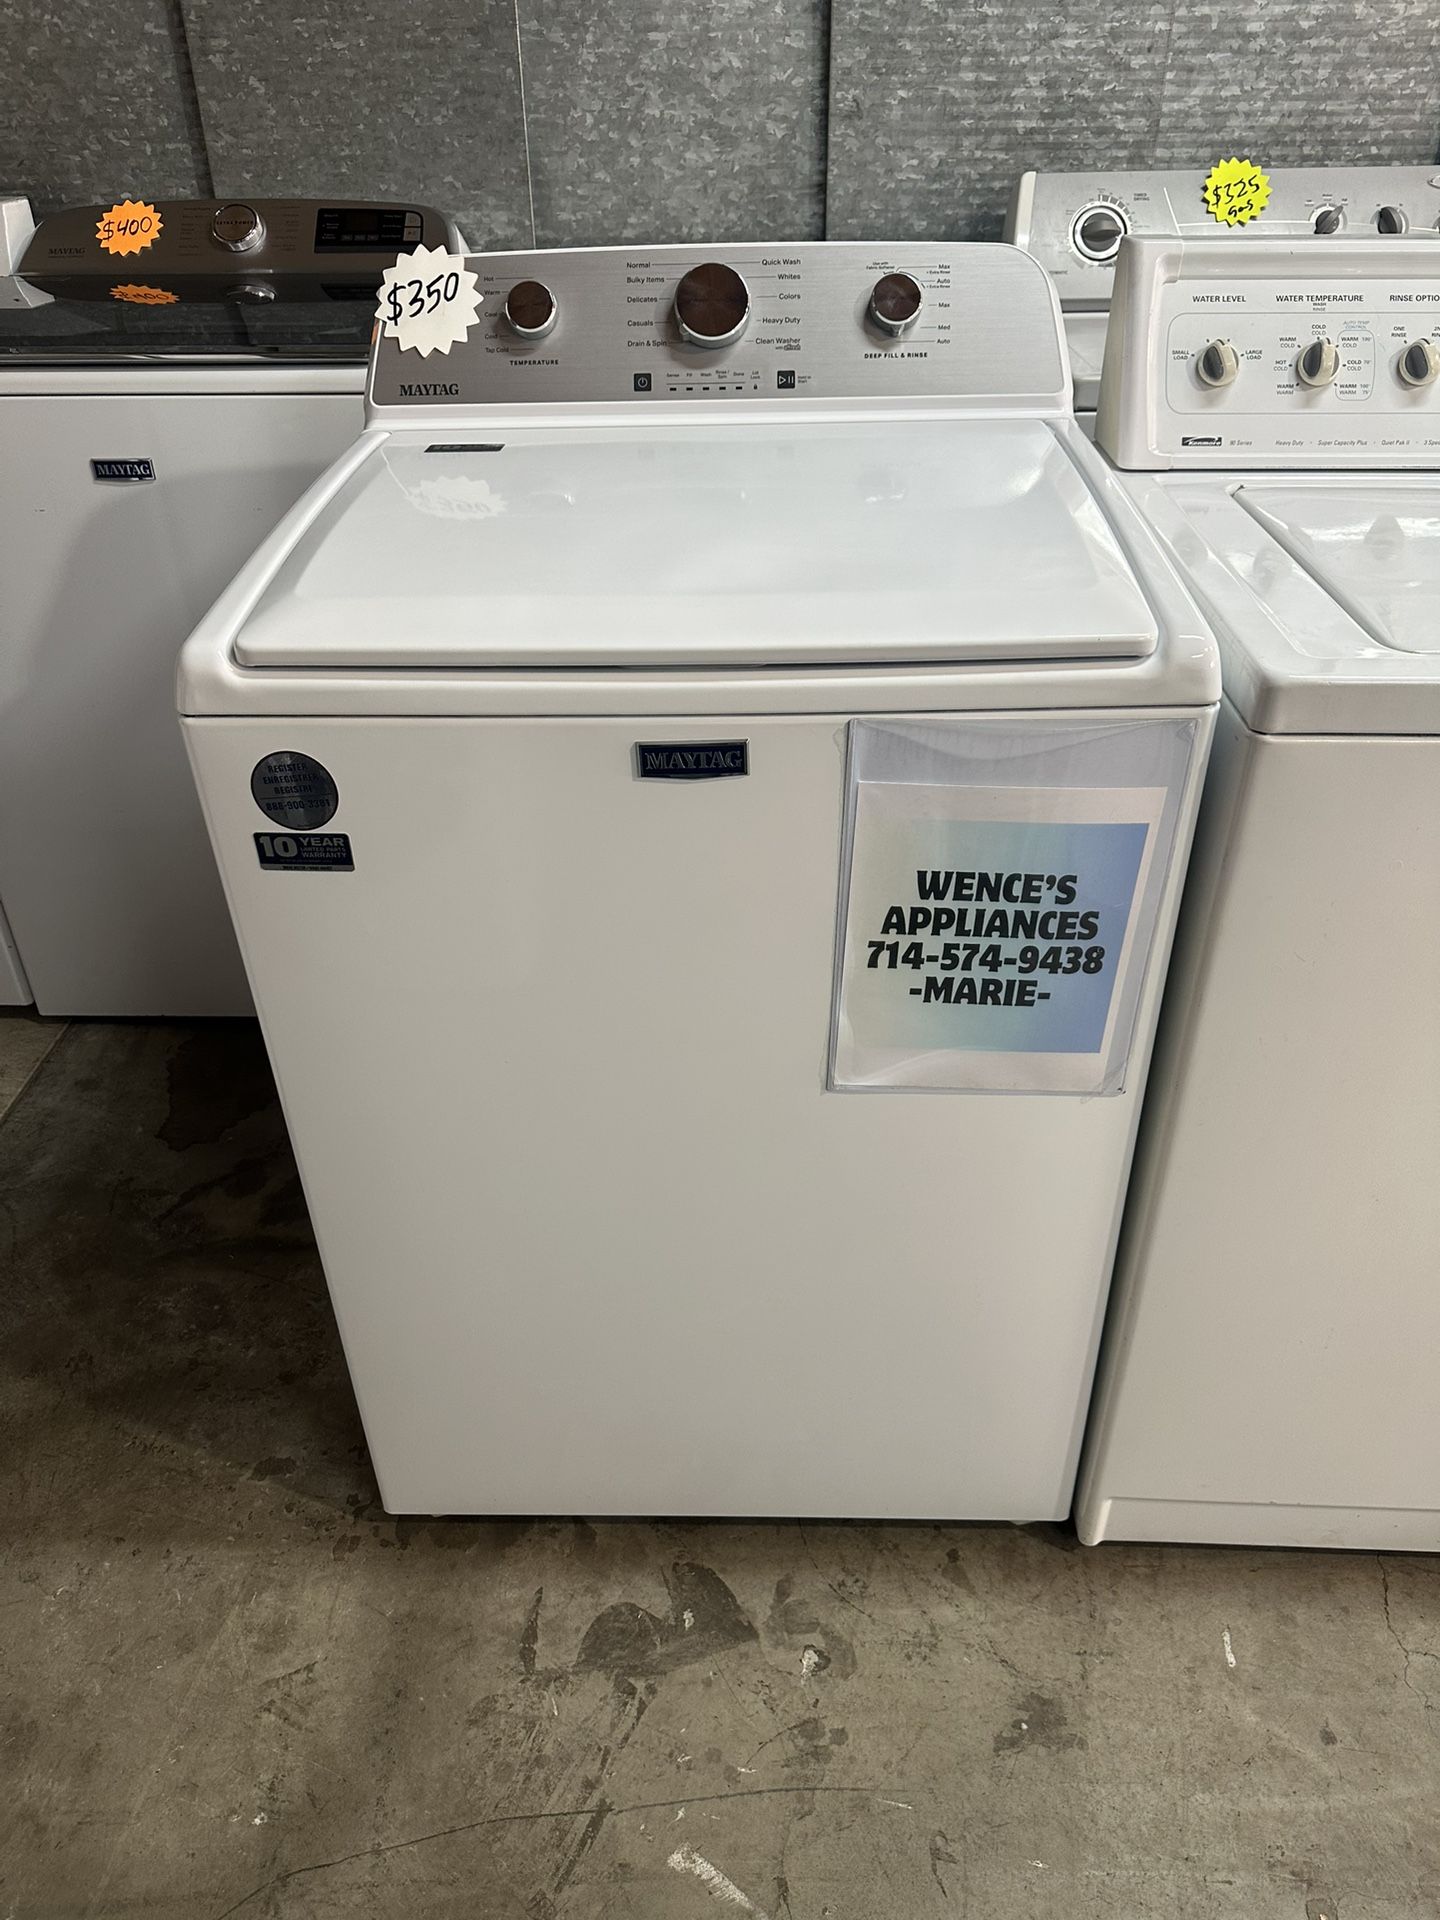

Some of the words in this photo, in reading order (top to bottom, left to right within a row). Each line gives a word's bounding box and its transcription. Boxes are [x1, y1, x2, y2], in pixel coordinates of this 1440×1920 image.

[1211, 174, 1260, 208] $325
[102, 216, 153, 241] $400
[626, 261, 651, 269] Normal
[761, 258, 781, 266] Quick
[626, 276, 645, 285] Bulky
[646, 275, 665, 283] Items
[387, 272, 460, 327] $350
[627, 296, 658, 304] Delicates
[778, 292, 801, 300] Colors
[1192, 295, 1220, 303] WATER
[1305, 294, 1365, 302] TEMPERATURE
[1389, 294, 1414, 302] RINSE
[627, 319, 654, 327] Casuals
[762, 316, 783, 325] Heavy
[784, 316, 801, 325] Duty
[627, 340, 645, 348] Drain
[652, 339, 668, 348] Spin
[755, 337, 775, 345] Clean
[775, 336, 801, 344] Washer
[399, 384, 459, 396] MAYTAG
[96, 464, 150, 475] MAYTAG
[644, 750, 742, 770] MAYTAG
[259, 835, 298, 857] 10
[299, 837, 345, 846] YEAR
[880, 905, 1100, 940] APPLIANCES
[866, 940, 1105, 975] 714-574-9438
[909, 976, 1051, 1007] -MARIE-
